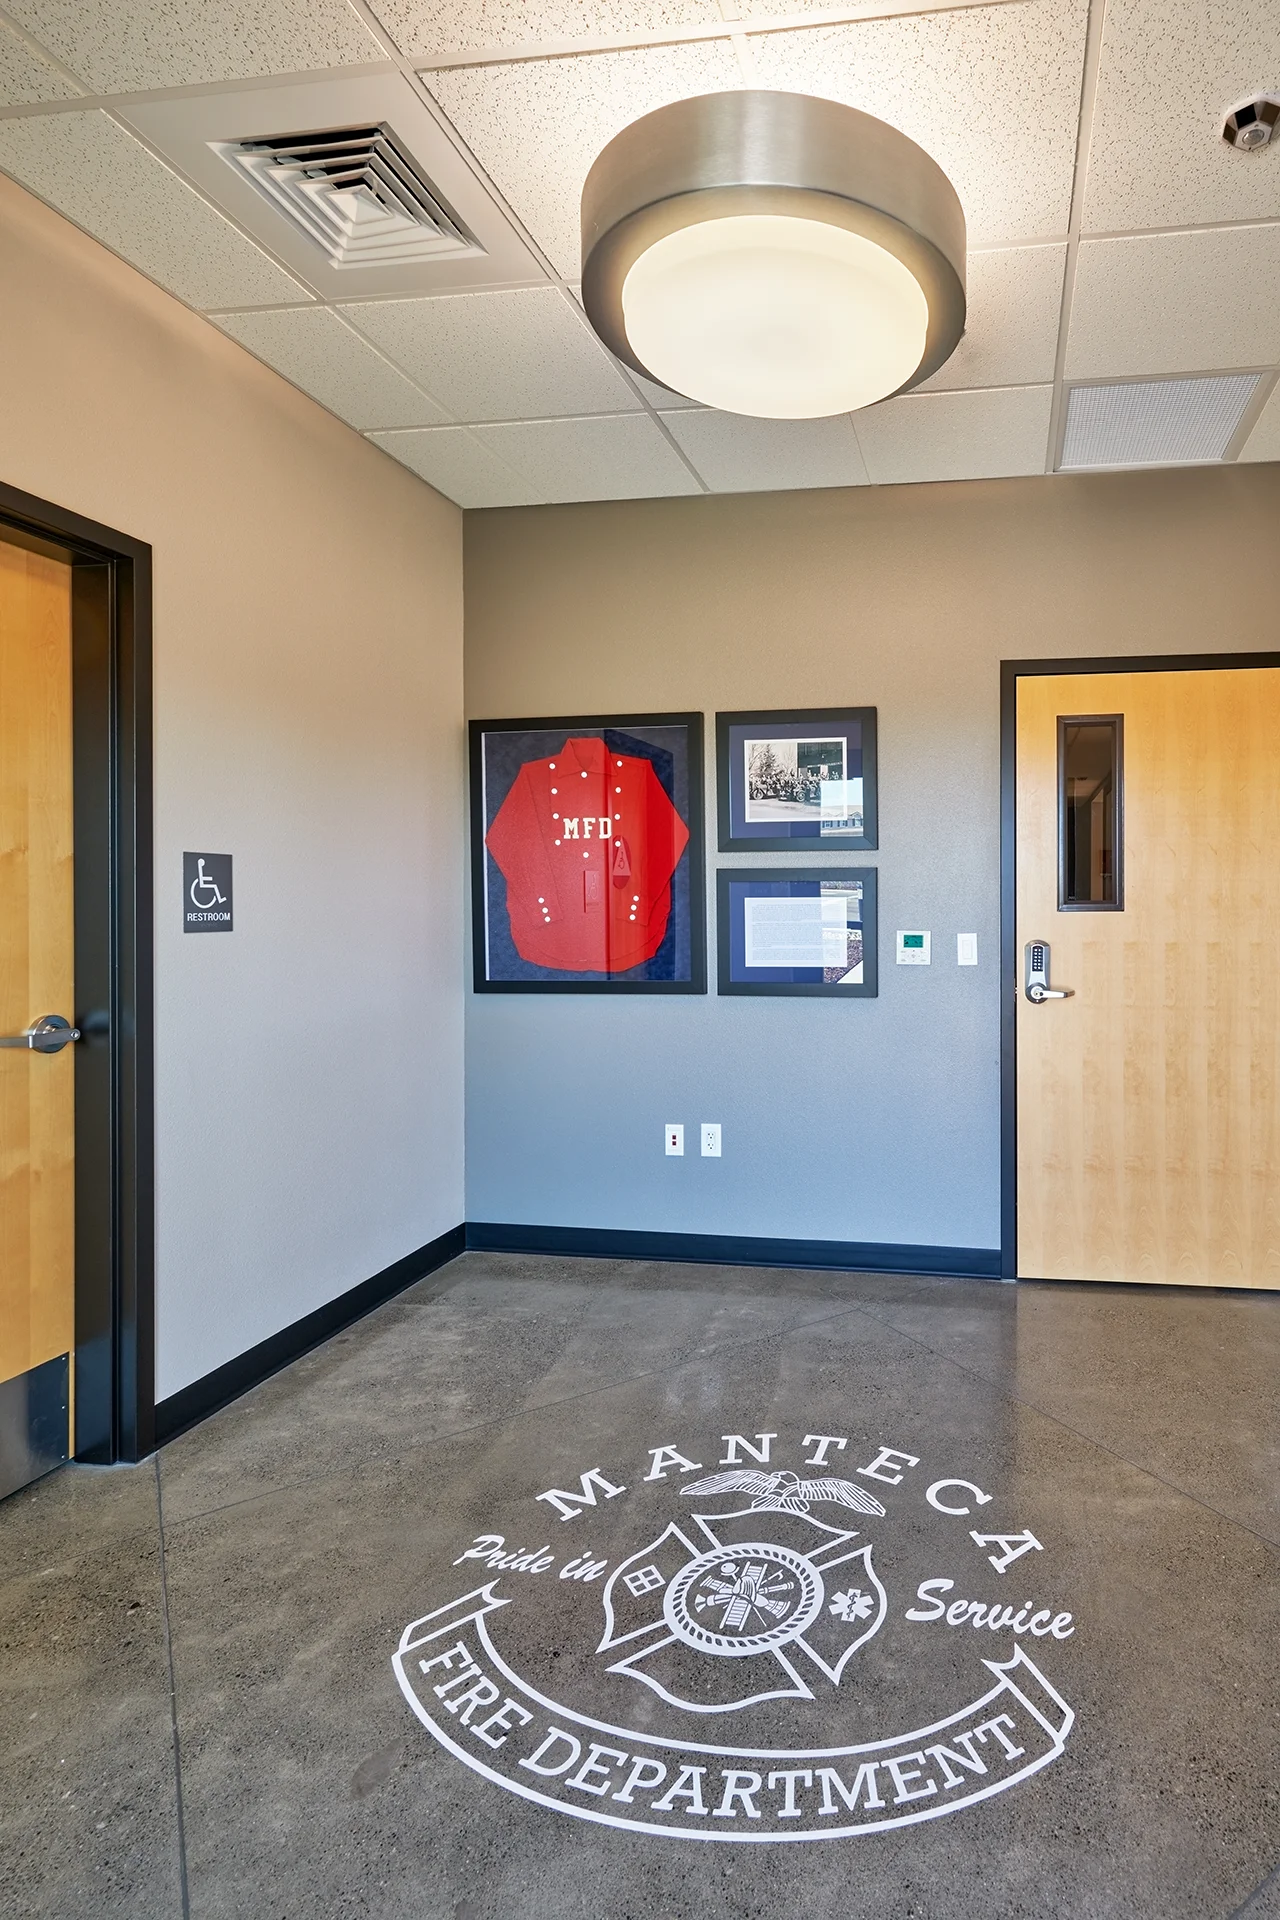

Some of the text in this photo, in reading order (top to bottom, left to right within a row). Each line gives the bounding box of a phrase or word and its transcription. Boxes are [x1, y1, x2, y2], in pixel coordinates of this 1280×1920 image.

[563, 817, 612, 839] MFD
[187, 912, 231, 922] RESTROOM
[535, 1433, 1044, 1574] MANTECA
[453, 1534, 608, 1583] Pride in
[906, 1579, 1075, 1640] Service
[418, 1641, 1025, 1817] FIRE DEPARTMENT
